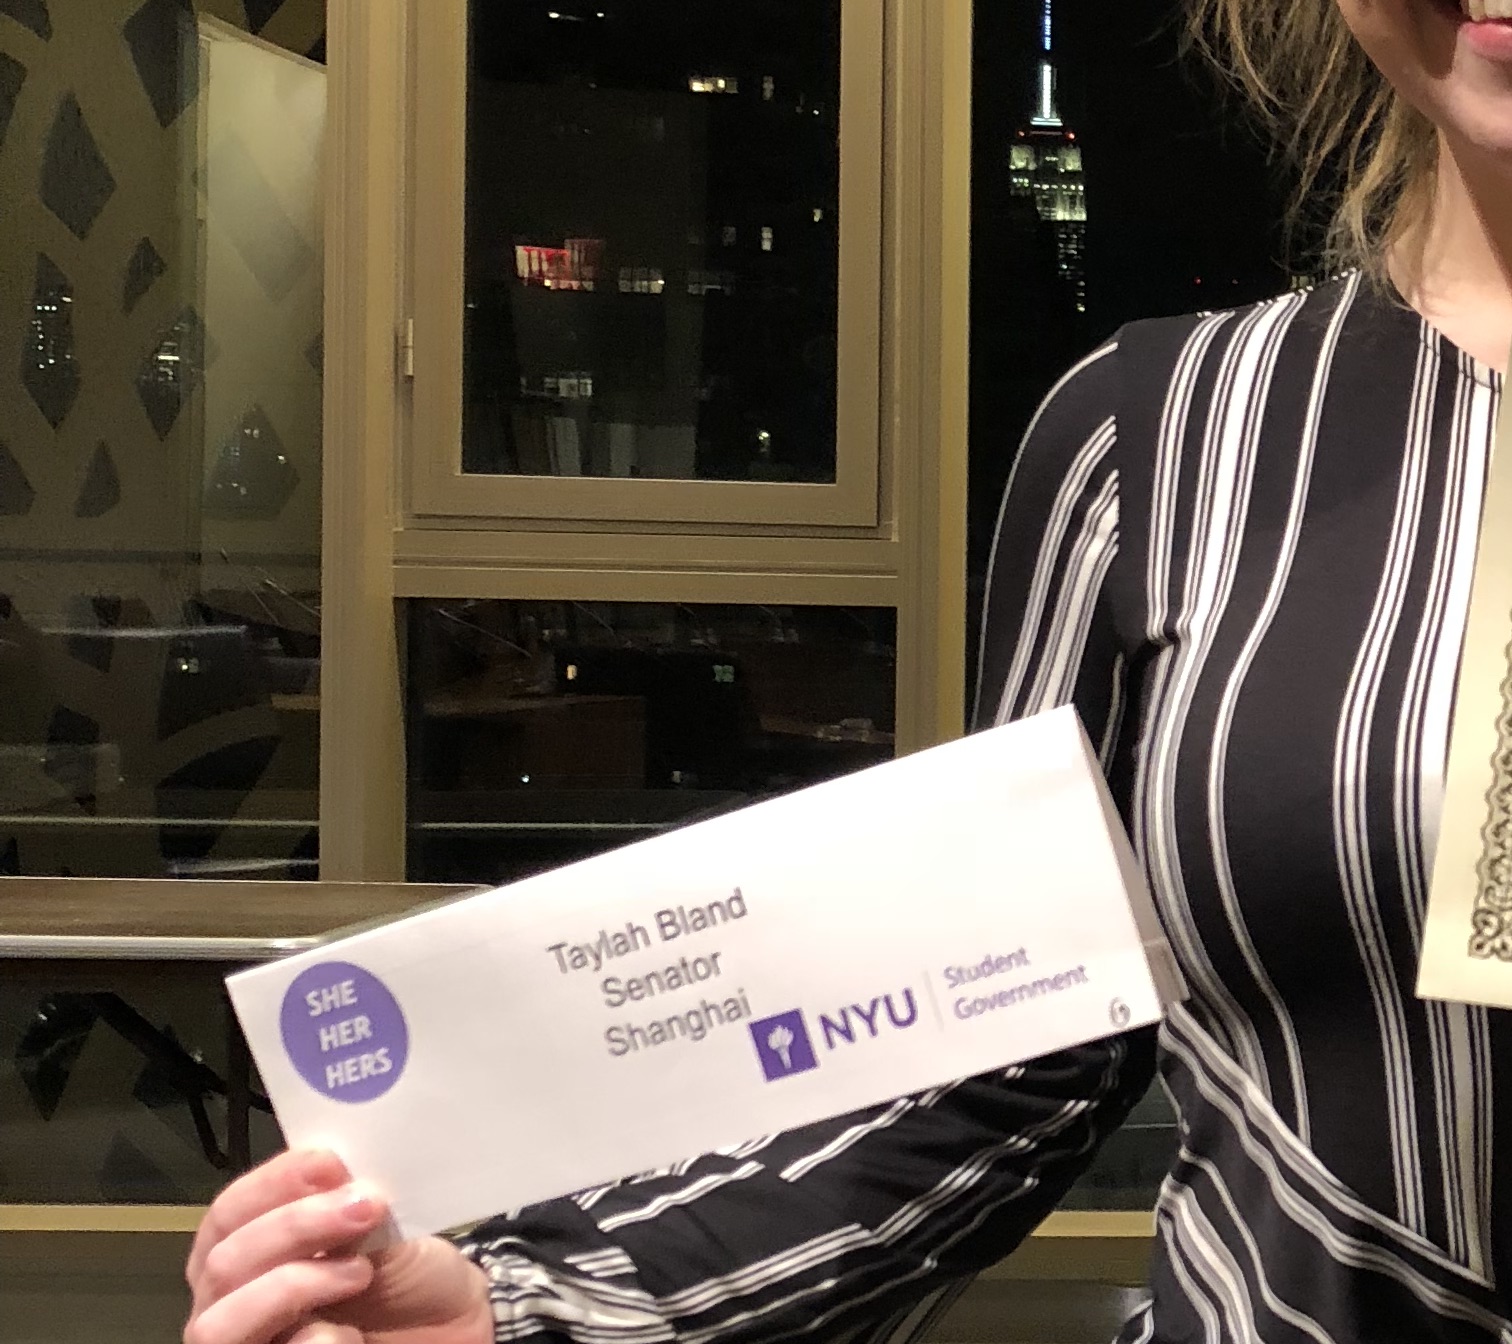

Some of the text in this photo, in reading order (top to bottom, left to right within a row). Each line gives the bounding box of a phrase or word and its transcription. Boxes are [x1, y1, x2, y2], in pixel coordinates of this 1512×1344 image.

[546, 887, 748, 974] Taylah Bland
[601, 951, 722, 1008] Senator
[943, 946, 1030, 989] Student
[953, 964, 1089, 1020] Government
[305, 979, 358, 1017] SHE
[604, 987, 752, 1057] Shanghai
[818, 986, 919, 1049] NYU
[318, 1014, 373, 1052] HER
[325, 1047, 393, 1089] HERS
